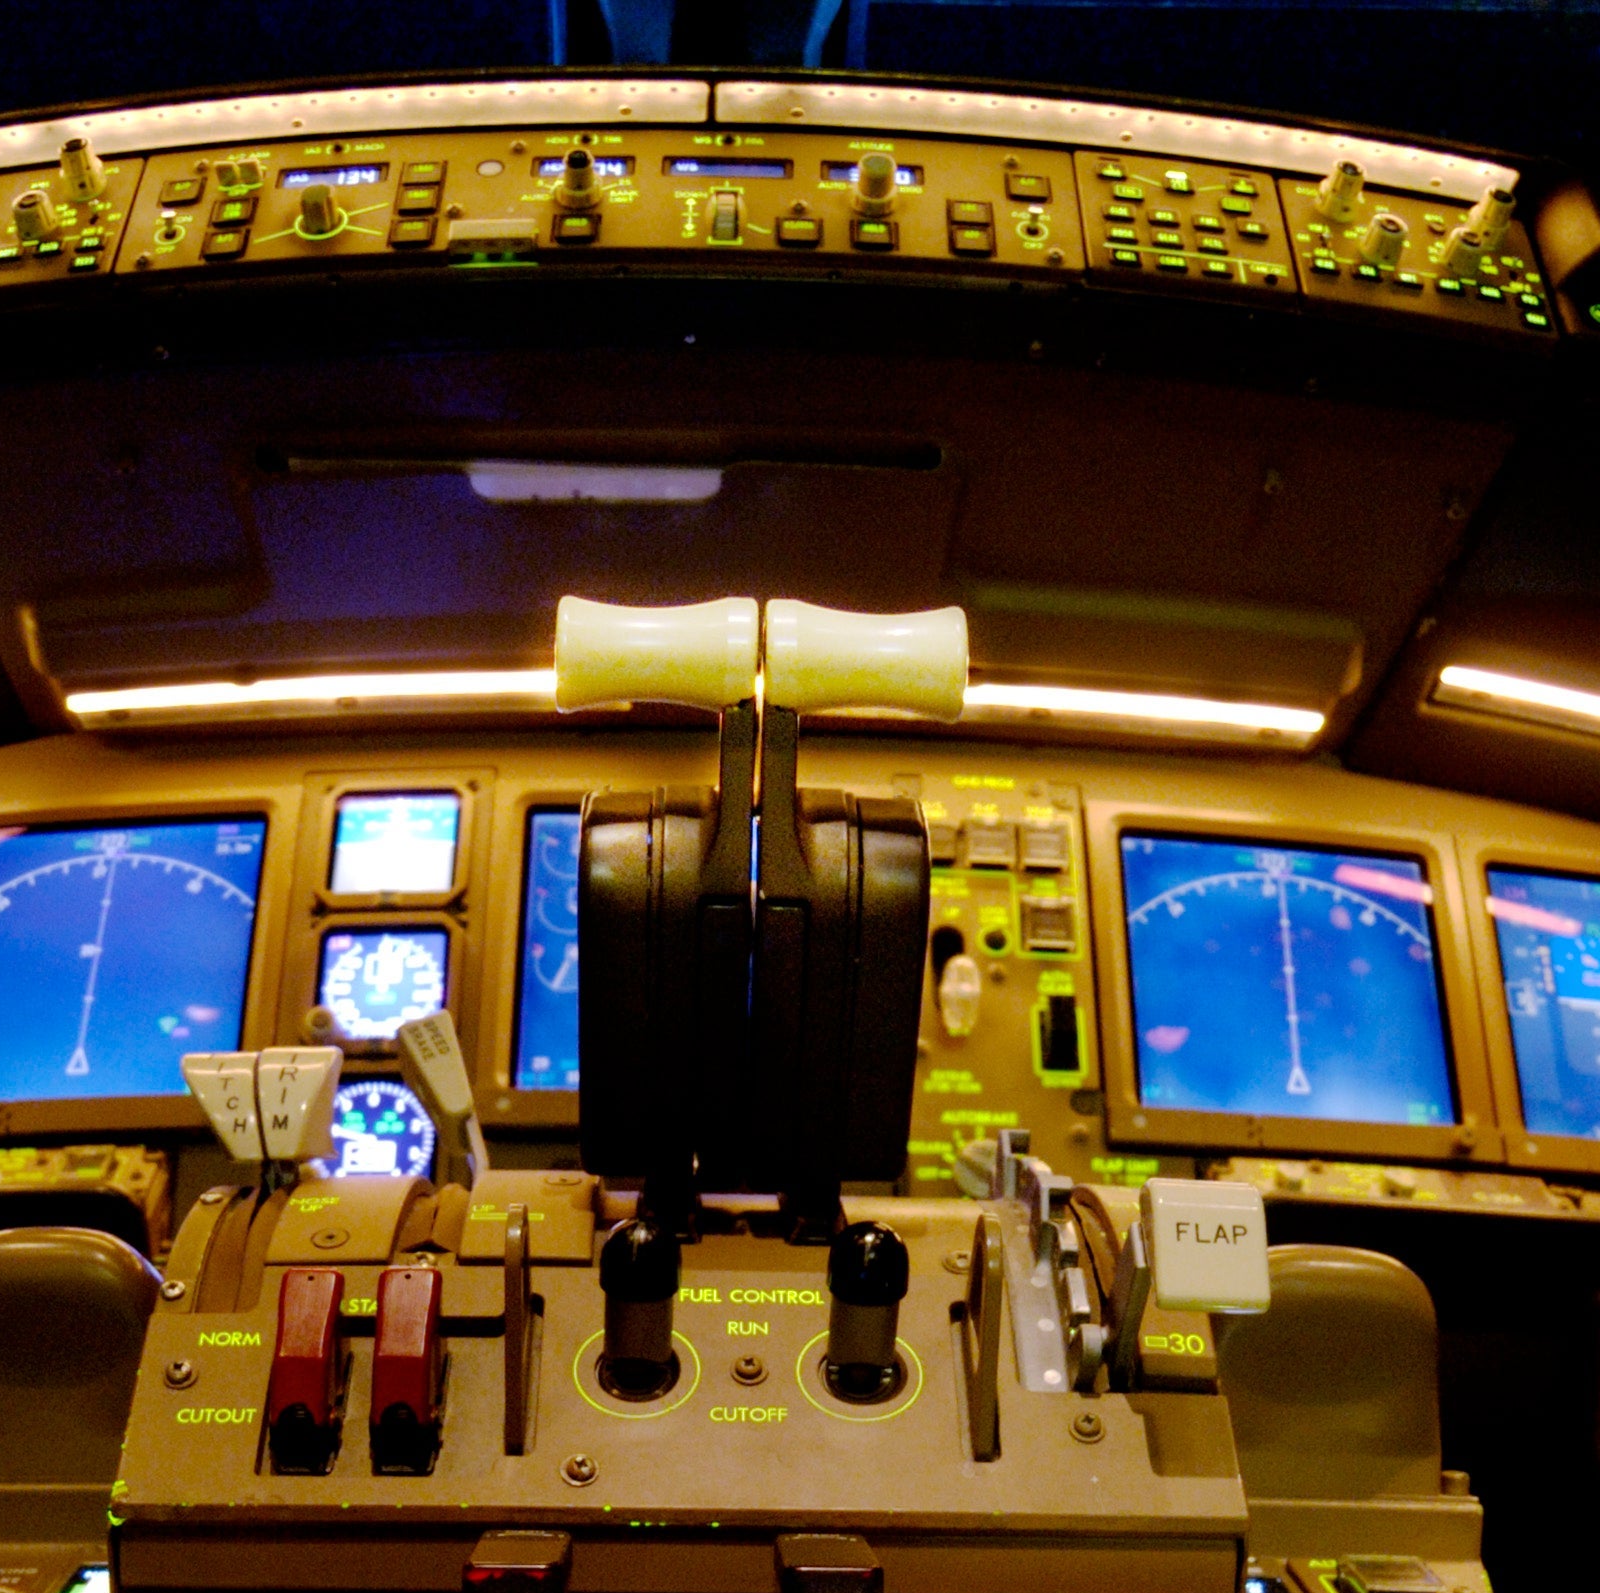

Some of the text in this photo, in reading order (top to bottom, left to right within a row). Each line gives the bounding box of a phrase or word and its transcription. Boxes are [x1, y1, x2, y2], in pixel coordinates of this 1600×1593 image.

[337, 170, 376, 184] 134
[1174, 1220, 1249, 1246] FLAP
[679, 1287, 825, 1306] FUEL CONTROL
[726, 1320, 769, 1336] RUN
[198, 1331, 262, 1347] NORM
[1169, 1333, 1205, 1355] 30
[176, 1408, 258, 1423] CUTOUT
[709, 1406, 789, 1424] CUTOFF
